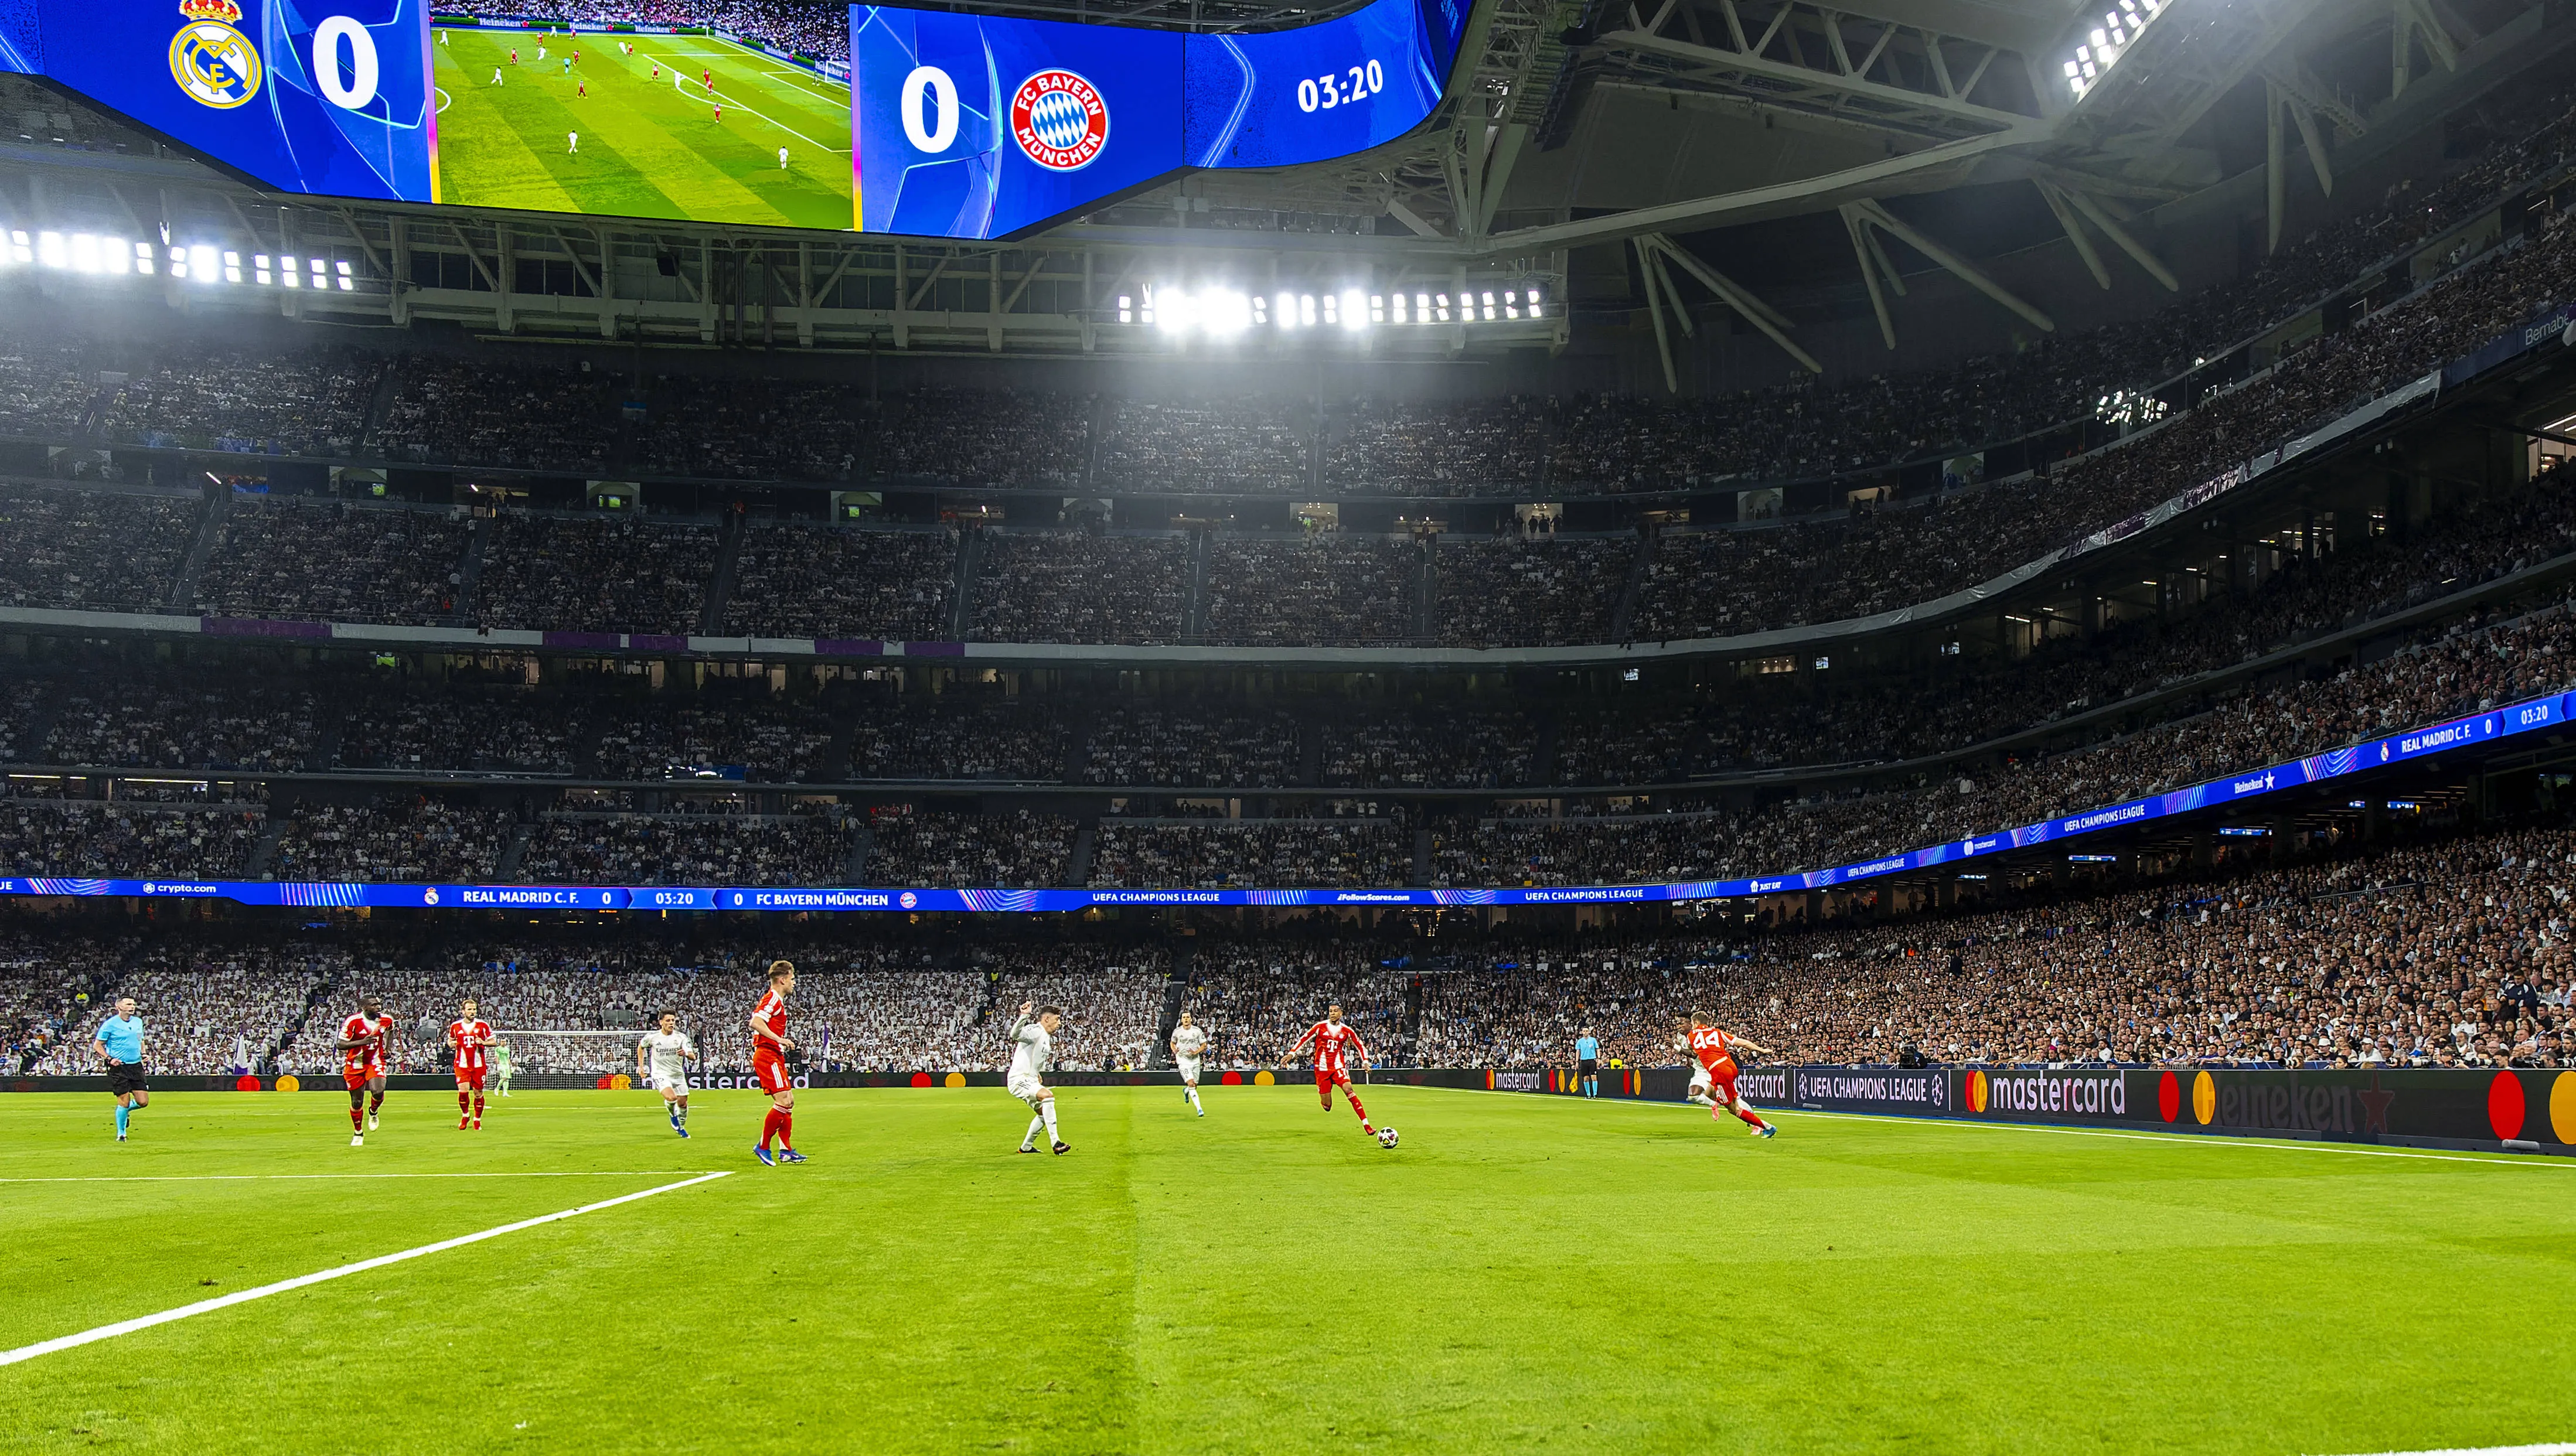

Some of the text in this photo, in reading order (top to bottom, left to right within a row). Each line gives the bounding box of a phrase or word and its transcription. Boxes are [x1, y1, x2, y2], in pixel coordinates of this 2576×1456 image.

[479, 17, 521, 28] Heineken
[568, 22, 606, 30] Heineken
[635, 25, 670, 33] Heineken
[312, 15, 379, 109] 0
[1297, 59, 1383, 112] 03:20
[1017, 75, 1102, 115] FC BAYERN
[899, 65, 959, 153] 0
[1018, 128, 1102, 165] MÜNCHEN
[2521, 705, 2548, 725] 03:20
[2485, 719, 2492, 734] 0
[2401, 724, 2471, 753] REAL MADRID C. F.
[2234, 776, 2264, 793] Heineken
[2064, 804, 2145, 831] UEFA CHAMPIONS LEAGUE
[1974, 839, 1996, 850] mastercard
[1848, 858, 1905, 877] UEFA CHAMPIONS LEAGUE
[158, 883, 216, 893] crypto.com
[1759, 881, 1782, 891] JUST EAT
[463, 891, 579, 903] REAL MADRID C. F.
[602, 891, 611, 905] 0
[655, 892, 693, 905] 03:20
[734, 893, 743, 905] 0
[757, 893, 772, 905] FC
[774, 893, 822, 905] BAYERN
[826, 892, 888, 906] MÜNCHEN
[1093, 893, 1219, 902] UEFA CHAMPIONS LEAGUE
[1525, 889, 1643, 901] UEFA CHAMPIONS LEAGUE
[1693, 1031, 1720, 1049] 44
[1496, 1069, 1540, 1089] mastercard
[1810, 1077, 1927, 1102] UEFA CHAMPIONS LEAGUE
[1994, 1070, 2125, 1114] mastercard
